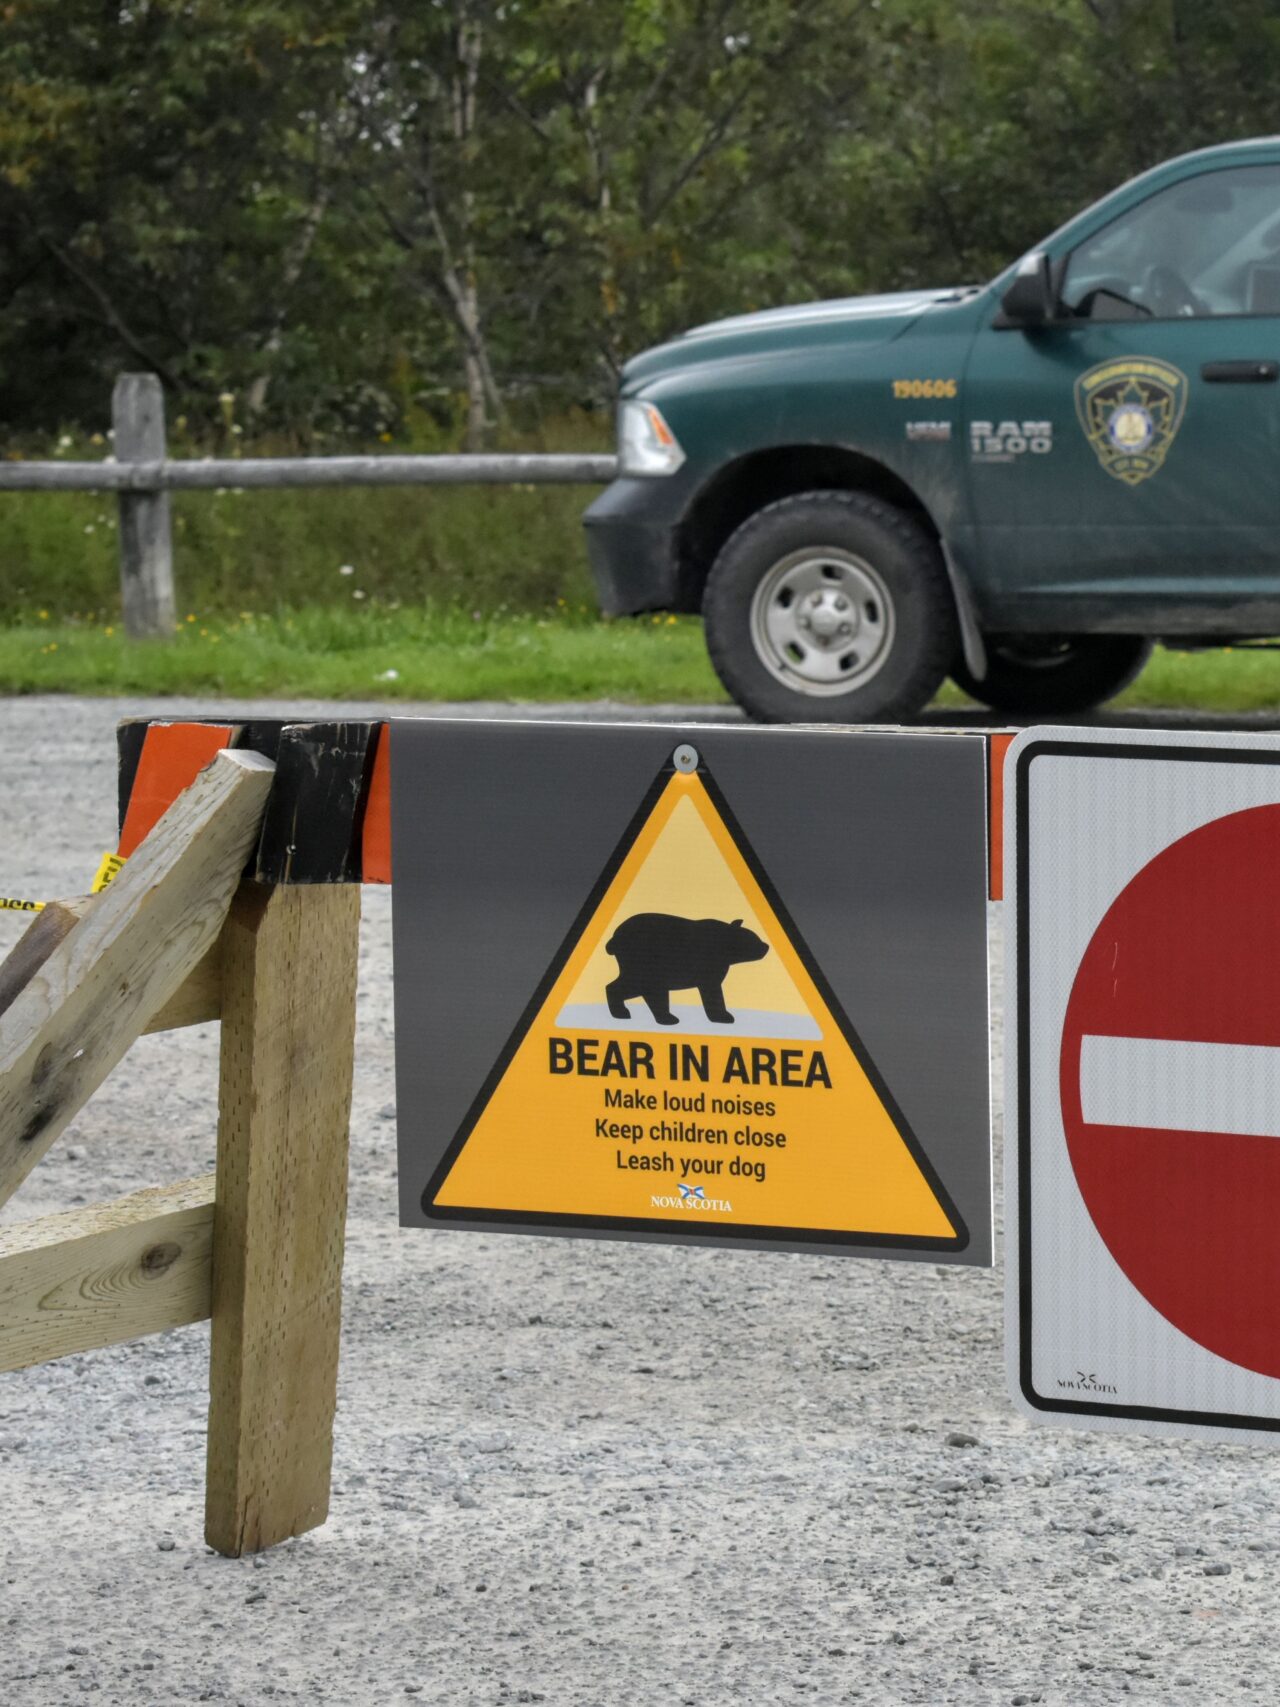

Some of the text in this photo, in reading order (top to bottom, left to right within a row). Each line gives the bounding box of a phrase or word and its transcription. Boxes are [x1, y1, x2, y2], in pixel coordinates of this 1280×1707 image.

[893, 378, 958, 399] 190606
[970, 421, 1052, 437] RAM
[970, 437, 1052, 454] 1500
[548, 1037, 833, 1090] BEAR IN AREA
[604, 1088, 776, 1117] Make loud noises
[595, 1118, 787, 1148] Keep children close
[616, 1150, 766, 1182] Leash your dog
[651, 1196, 733, 1212] NOVA SCOTIA
